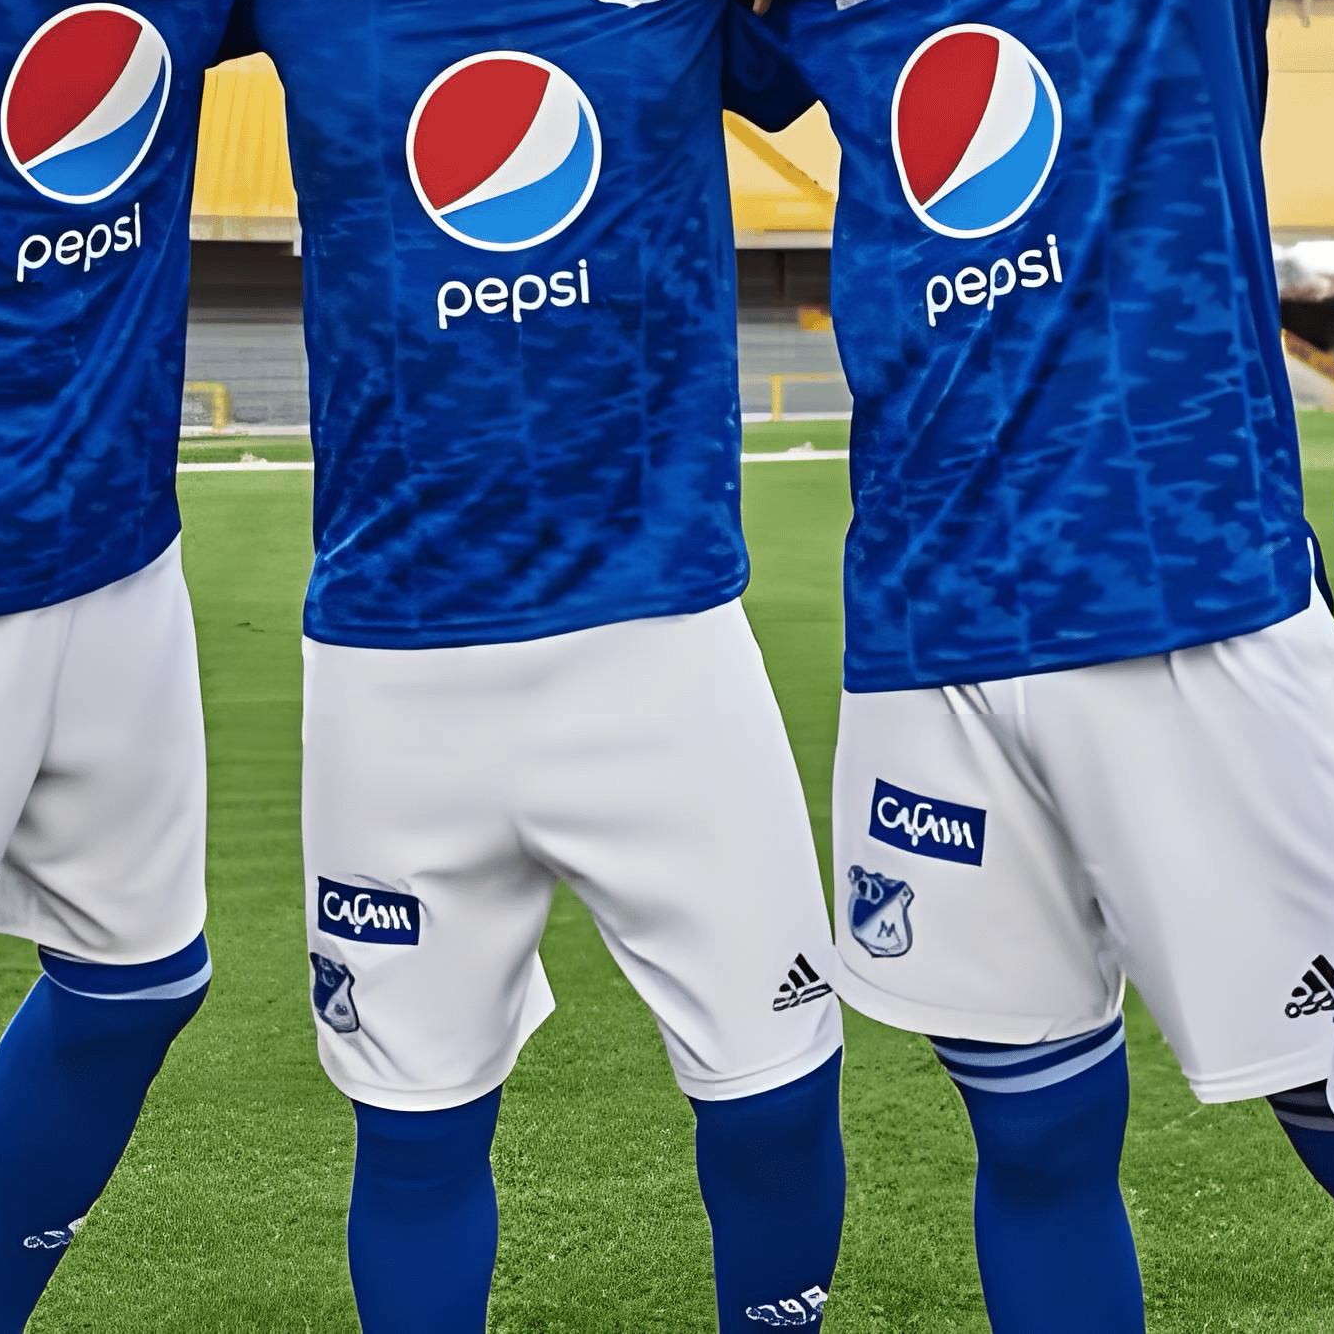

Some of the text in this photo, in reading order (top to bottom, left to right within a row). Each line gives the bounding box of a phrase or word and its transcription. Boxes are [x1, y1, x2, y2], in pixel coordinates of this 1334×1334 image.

[16, 203, 142, 283] pepsi
[926, 235, 1063, 327] pepsi
[437, 258, 590, 330] pepsi
